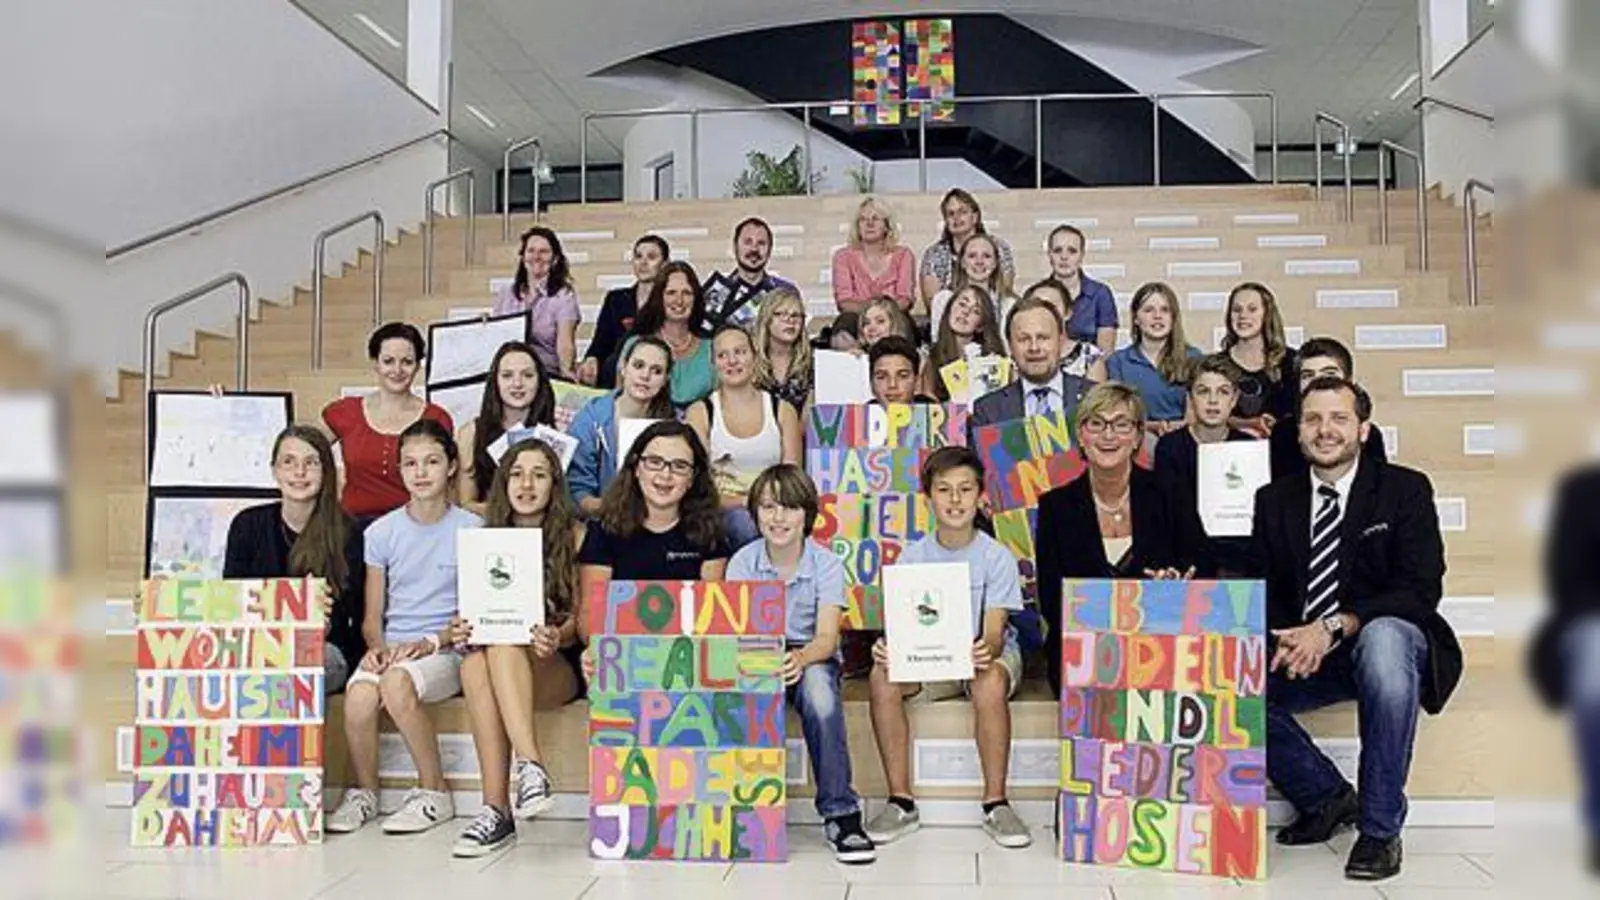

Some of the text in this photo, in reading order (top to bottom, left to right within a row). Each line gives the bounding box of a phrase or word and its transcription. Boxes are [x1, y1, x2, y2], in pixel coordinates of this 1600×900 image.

[143, 578, 310, 622] LEBEN
[1063, 632, 1265, 697] JODELN
[137, 673, 323, 720] HAUSEN
[1062, 688, 1250, 748] DIRNDL
[1062, 796, 1261, 878] HOSEN
